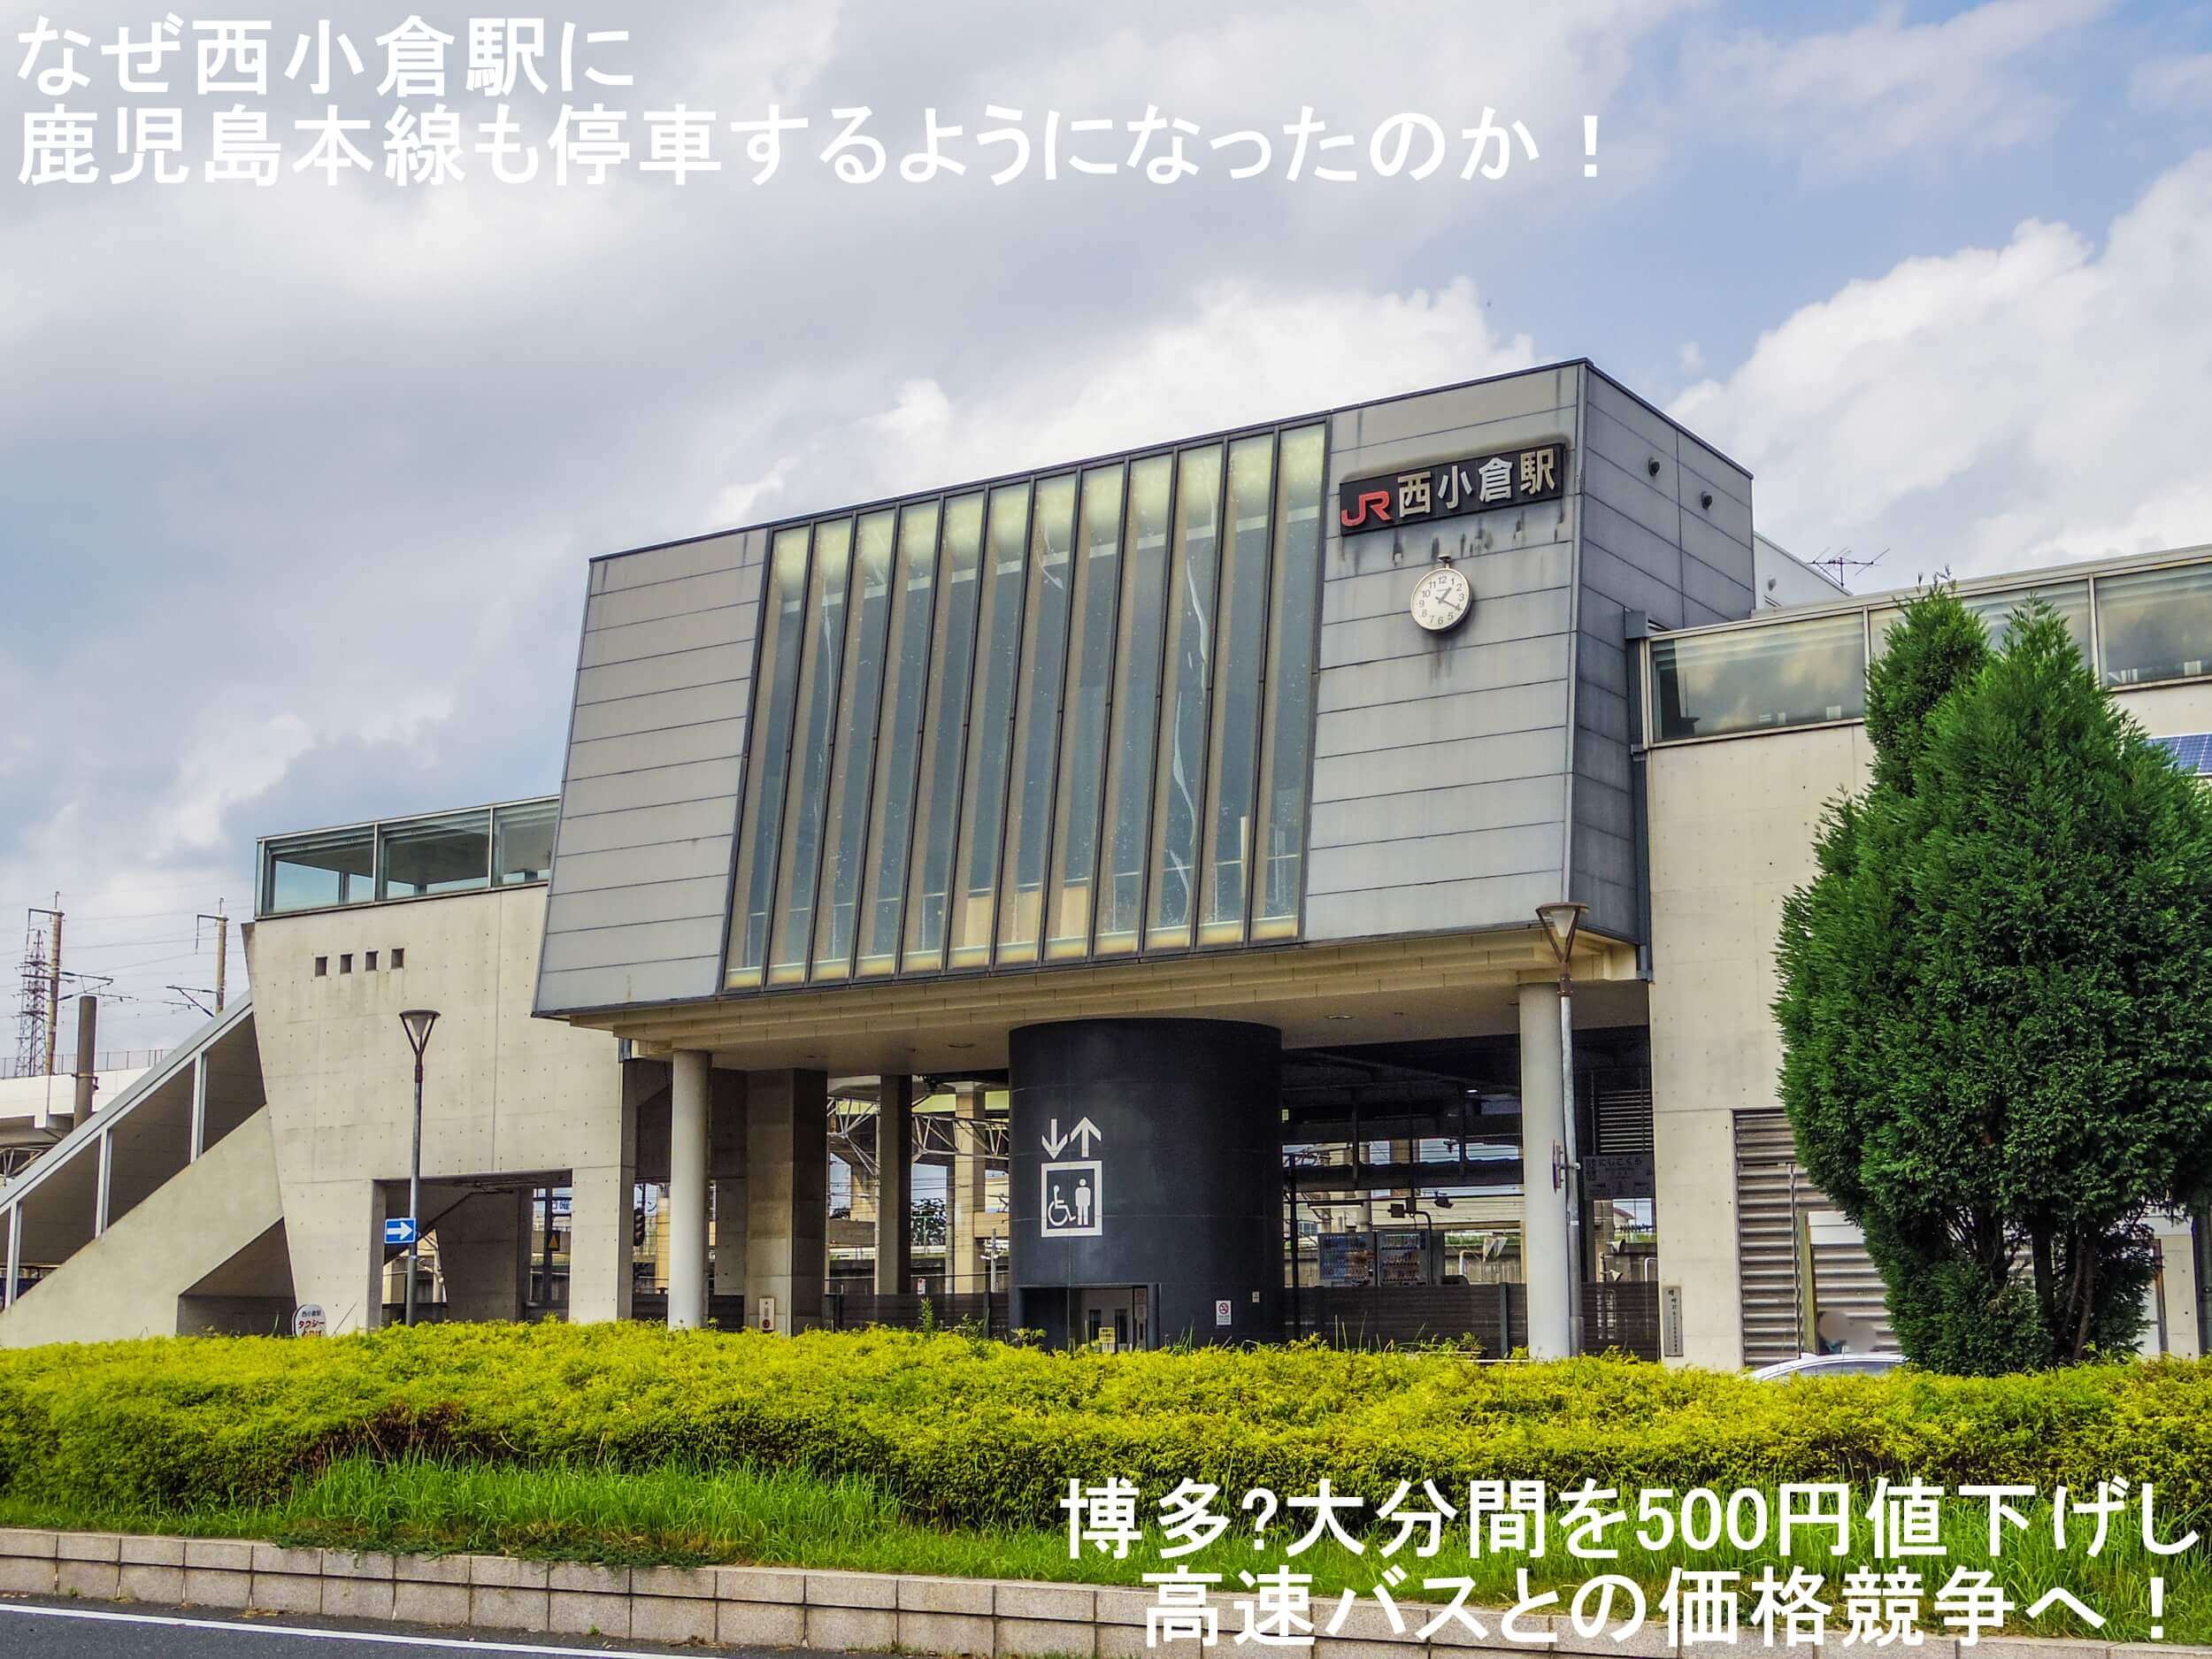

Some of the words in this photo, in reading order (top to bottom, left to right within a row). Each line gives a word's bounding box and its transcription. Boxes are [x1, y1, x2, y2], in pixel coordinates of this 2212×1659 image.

[1340, 490, 1394, 527] JR
[1397, 448, 1555, 518] 西小倉駅
[1438, 575, 1448, 584] 12
[298, 1319, 326, 1329] タクシー
